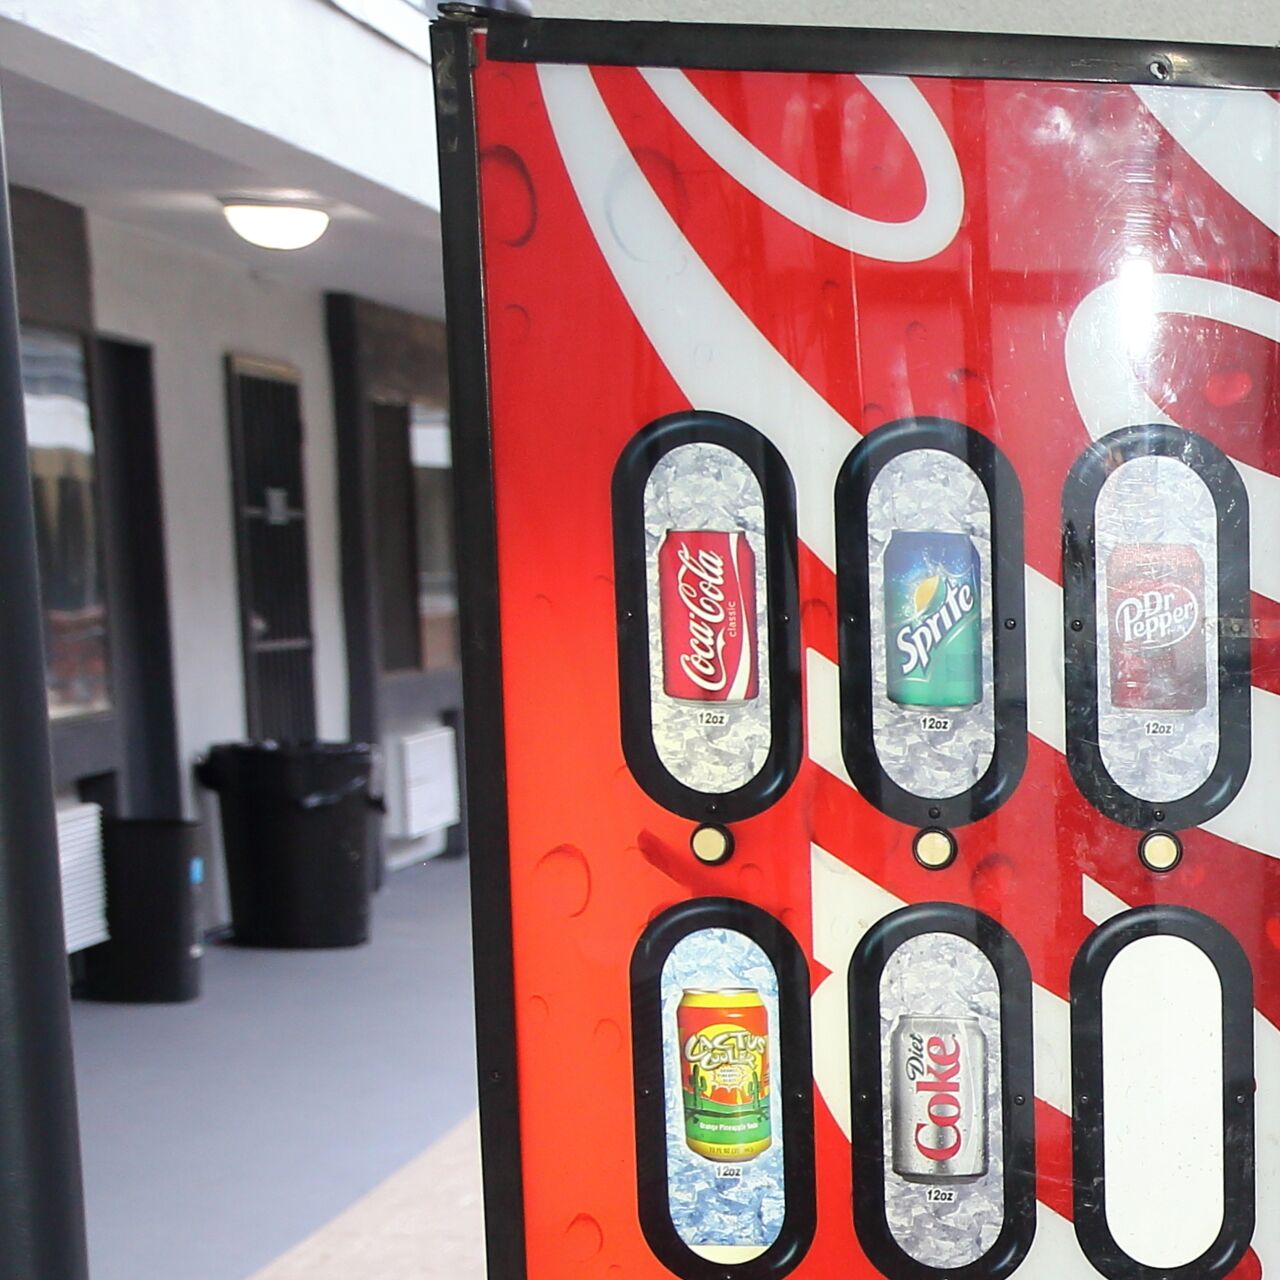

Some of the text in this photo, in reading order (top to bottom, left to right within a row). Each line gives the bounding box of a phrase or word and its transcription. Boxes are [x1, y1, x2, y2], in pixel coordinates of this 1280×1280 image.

[1141, 590, 1176, 616] Dr
[728, 600, 737, 638] classic
[897, 576, 975, 675] Sprite
[1115, 597, 1195, 642] Pepper
[698, 712, 726, 726] 12oz
[920, 717, 949, 731] 12oz
[1143, 722, 1174, 736] 12oz
[684, 1031, 767, 1062] CACTUS
[905, 1034, 926, 1081] Diet
[913, 1035, 961, 1162] Coke
[720, 1123, 746, 1132] Pineapple
[716, 1167, 741, 1177] 12oz
[926, 1189, 954, 1202] 12oz
